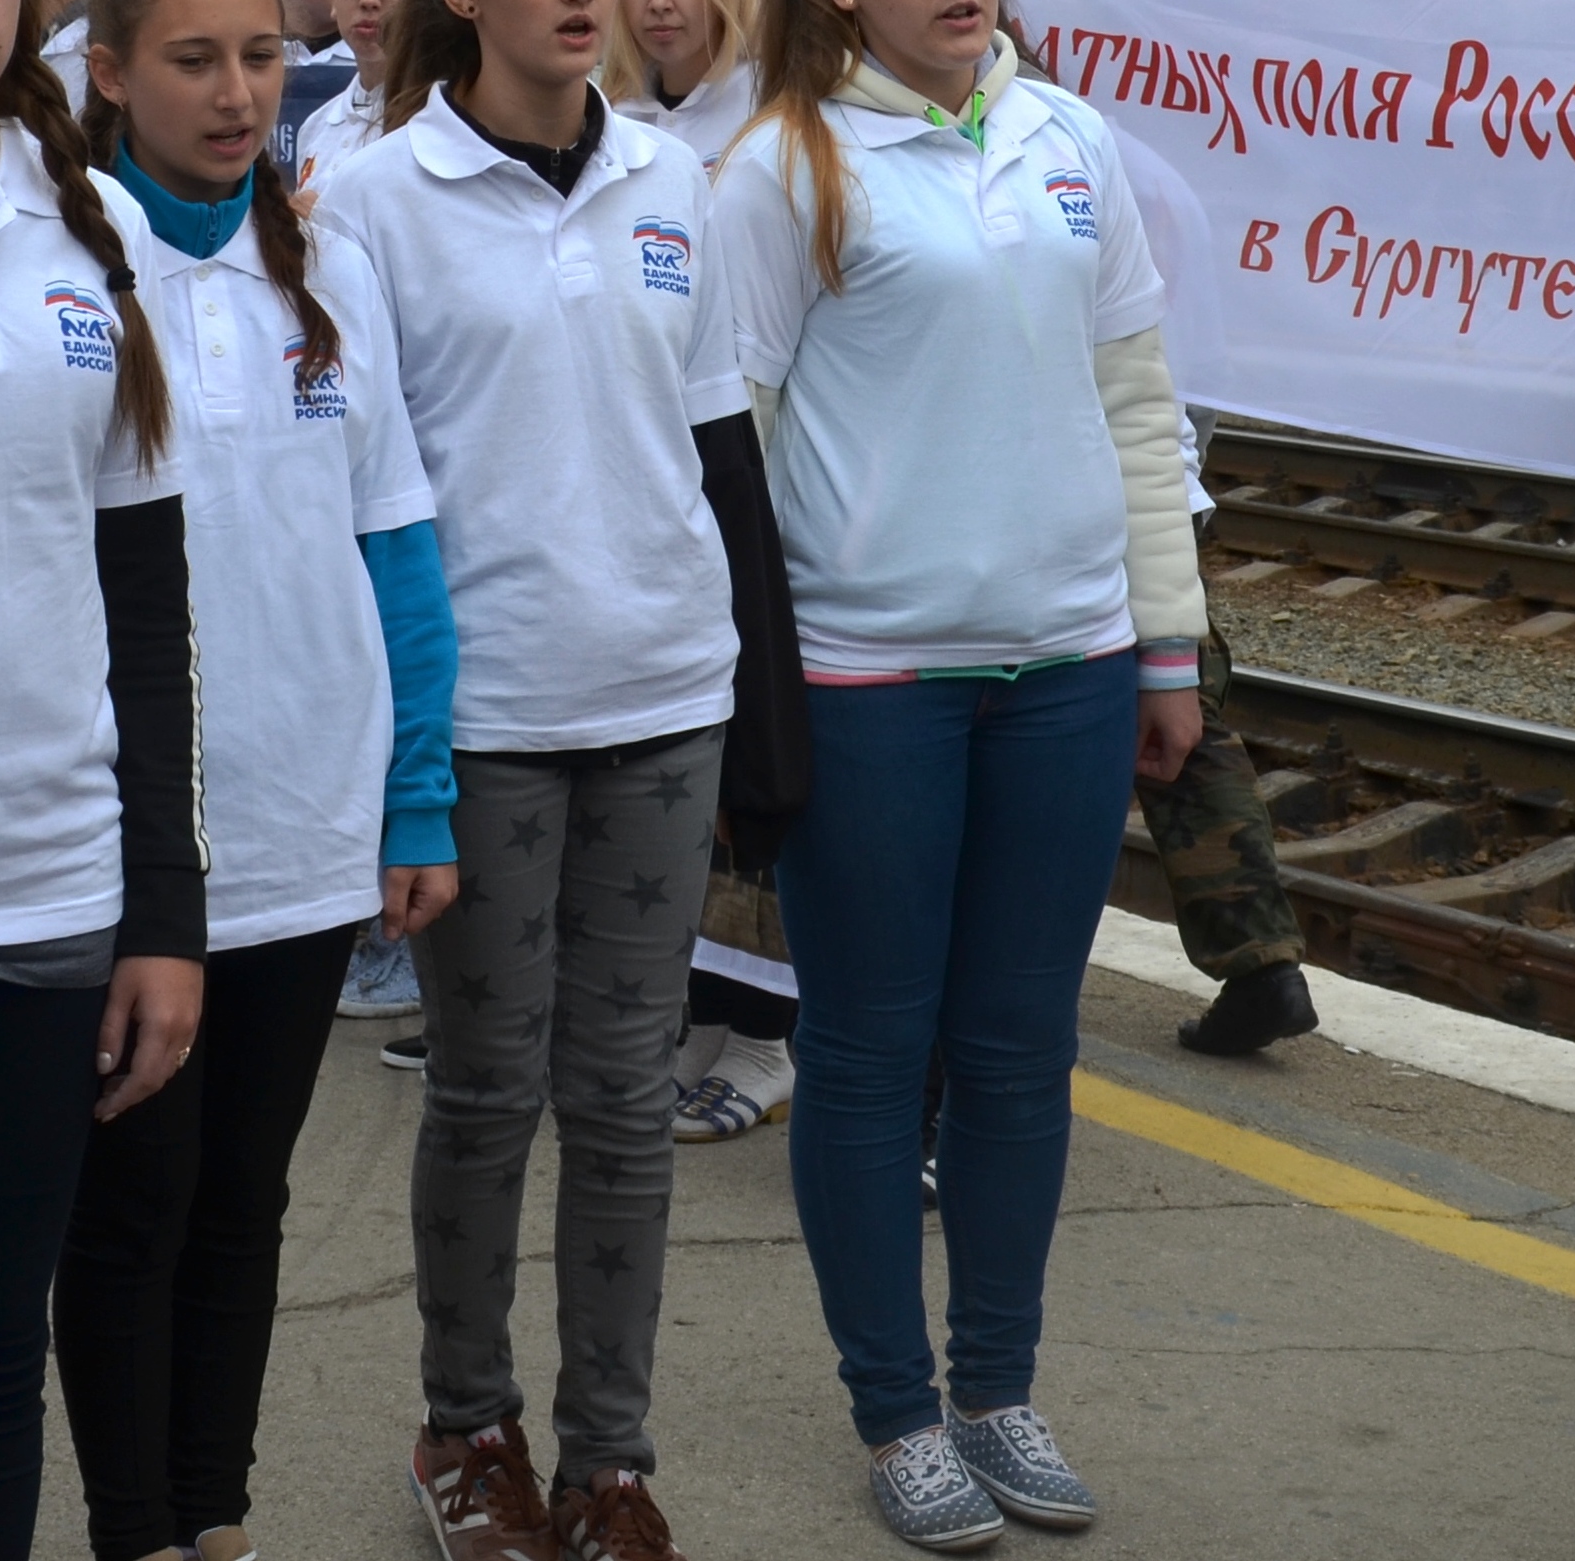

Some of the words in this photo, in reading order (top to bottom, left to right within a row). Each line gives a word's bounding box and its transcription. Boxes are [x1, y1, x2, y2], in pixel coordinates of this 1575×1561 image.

[1012, 17, 1247, 154] атных
[1252, 58, 1413, 144] поля
[1070, 227, 1098, 241] РОСС
[1239, 219, 1280, 272] в
[643, 267, 690, 285] ЕДИНАЯ
[645, 278, 690, 297] РОССИЯ
[293, 393, 348, 406] ЕДИНАЯ
